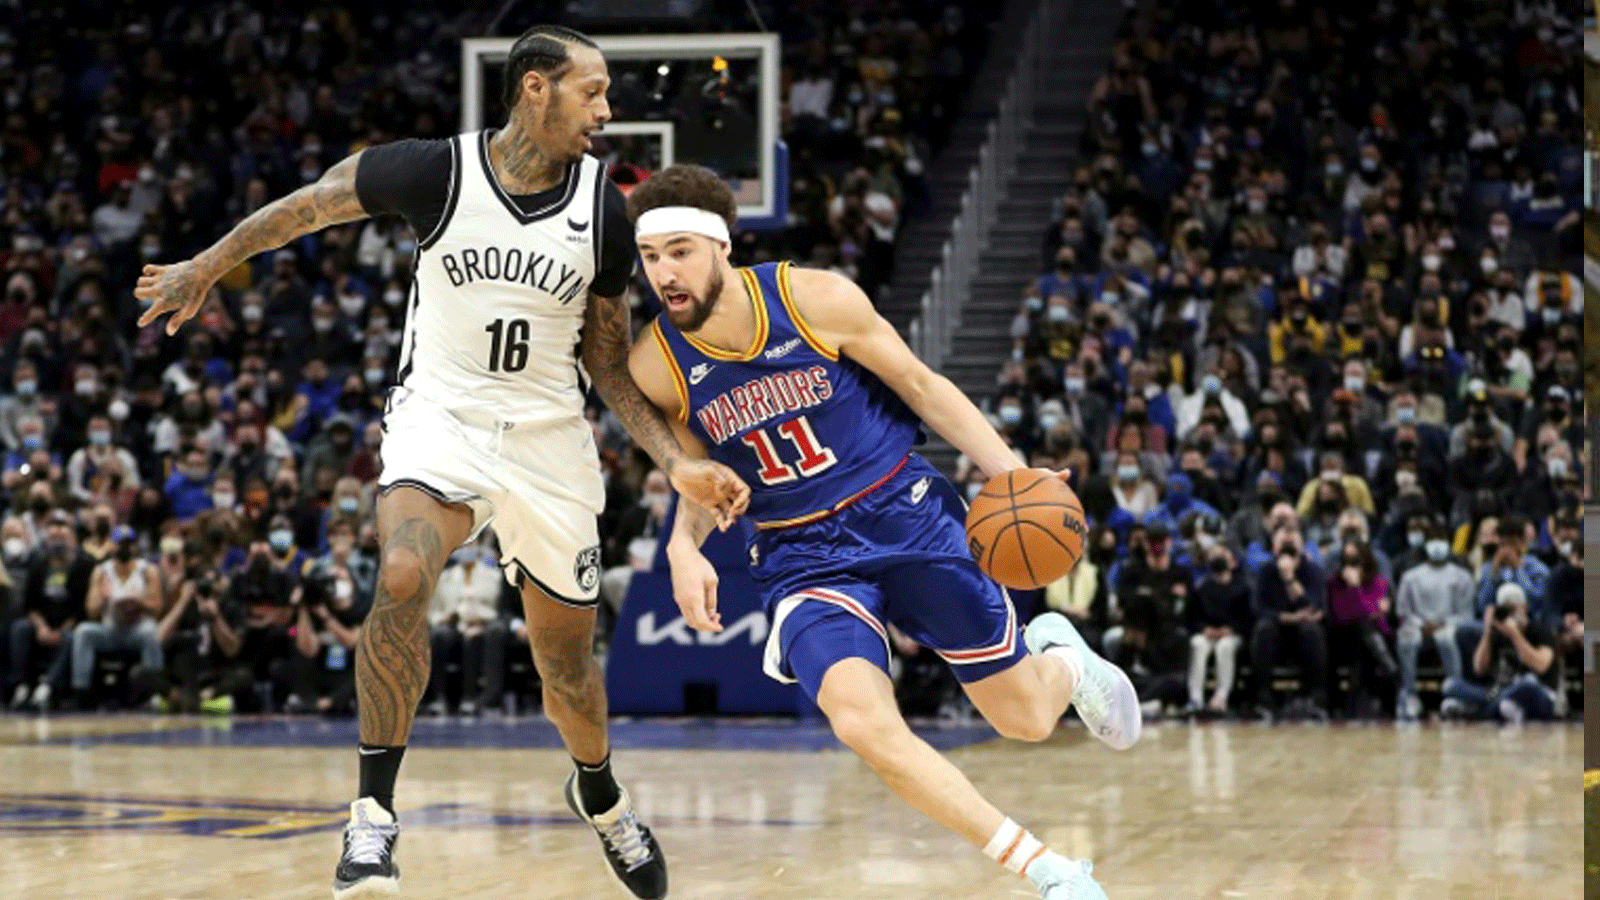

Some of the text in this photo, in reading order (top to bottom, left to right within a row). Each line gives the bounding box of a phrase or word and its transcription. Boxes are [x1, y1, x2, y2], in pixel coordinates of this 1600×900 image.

[441, 247, 584, 305] BROOKLYN
[485, 318, 531, 373] 16
[696, 365, 833, 445] WARRIORS
[742, 415, 838, 485] 11
